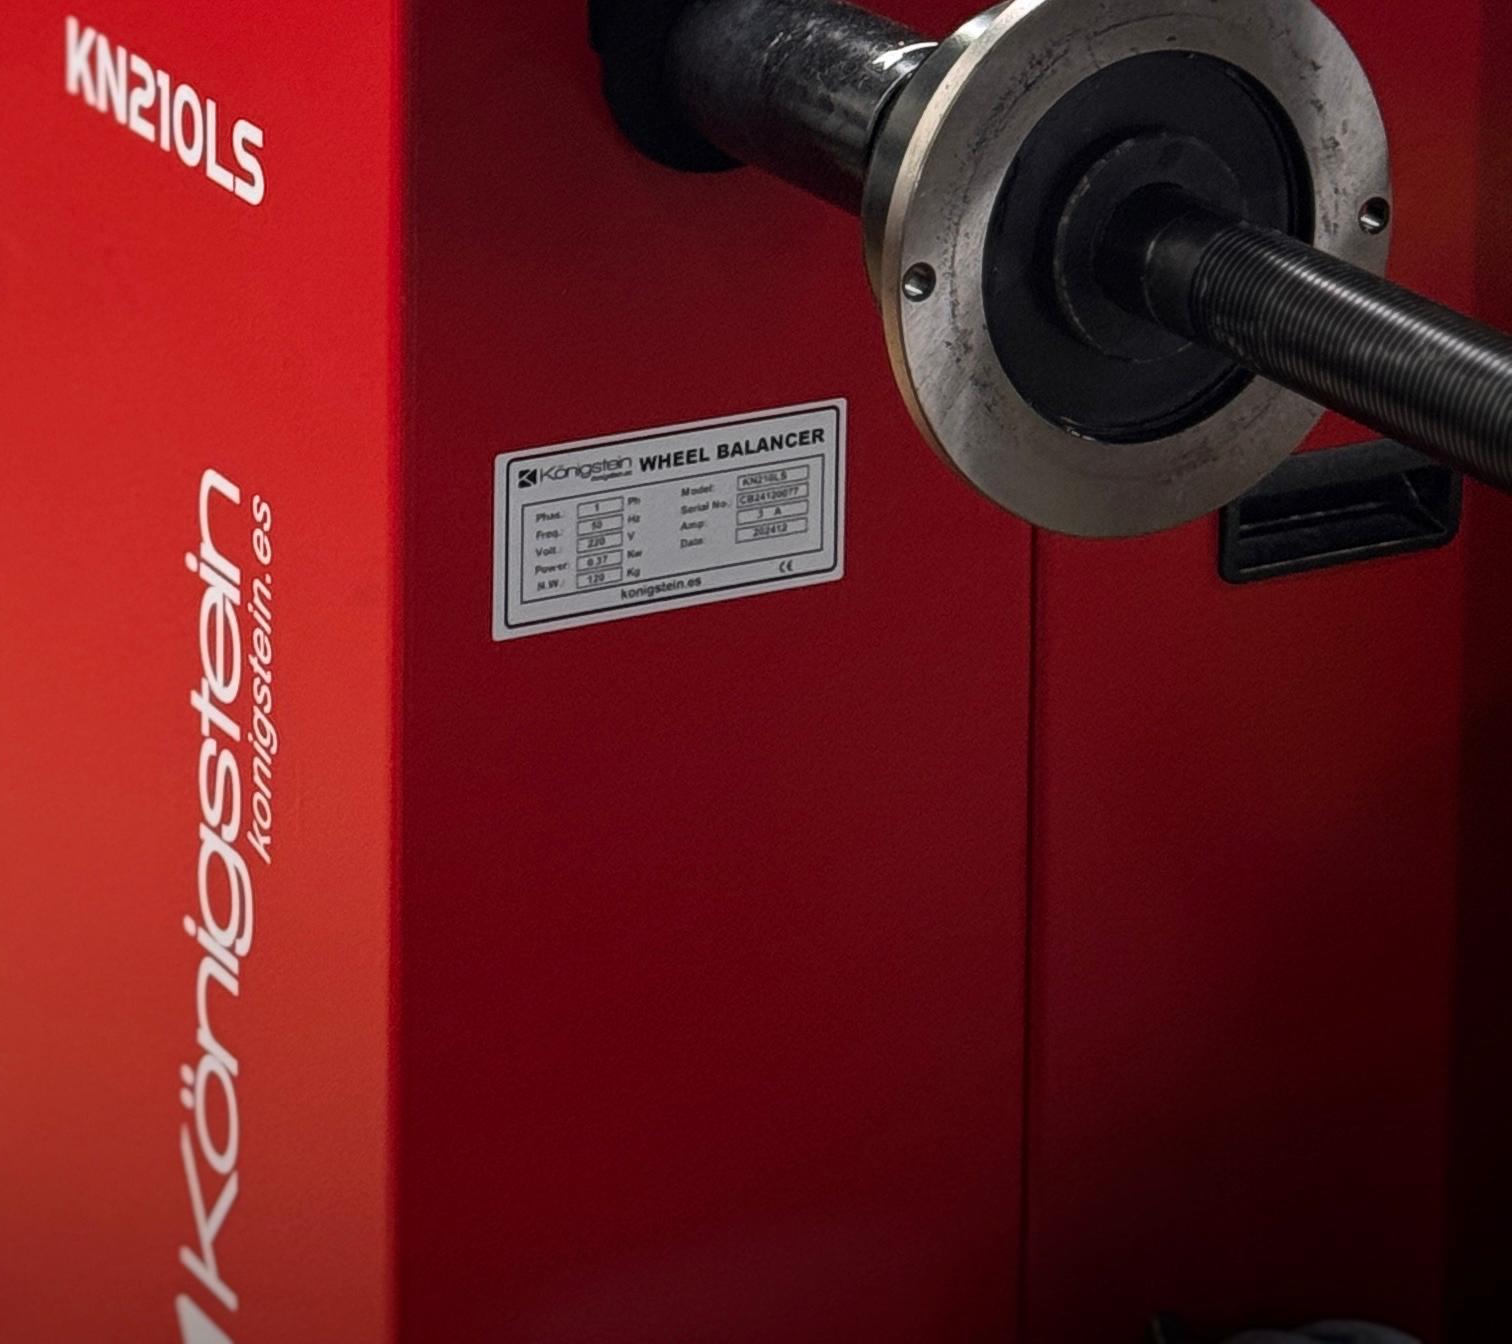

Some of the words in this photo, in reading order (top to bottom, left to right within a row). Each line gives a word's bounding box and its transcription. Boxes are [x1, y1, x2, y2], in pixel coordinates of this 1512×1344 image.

[65, 15, 266, 207] KN210LS
[639, 447, 710, 472] WHEEL
[716, 428, 825, 460] BALANCER
[594, 503, 600, 511] 1
[680, 501, 709, 515] Serial
[774, 507, 782, 515] A
[588, 536, 606, 548] 220
[627, 531, 636, 541] V
[587, 573, 605, 584] 120
[627, 567, 641, 578] Kg
[620, 577, 702, 600] konigstein.es
[247, 494, 278, 865] konigstein.es
[179, 468, 254, 1309] Königstein
